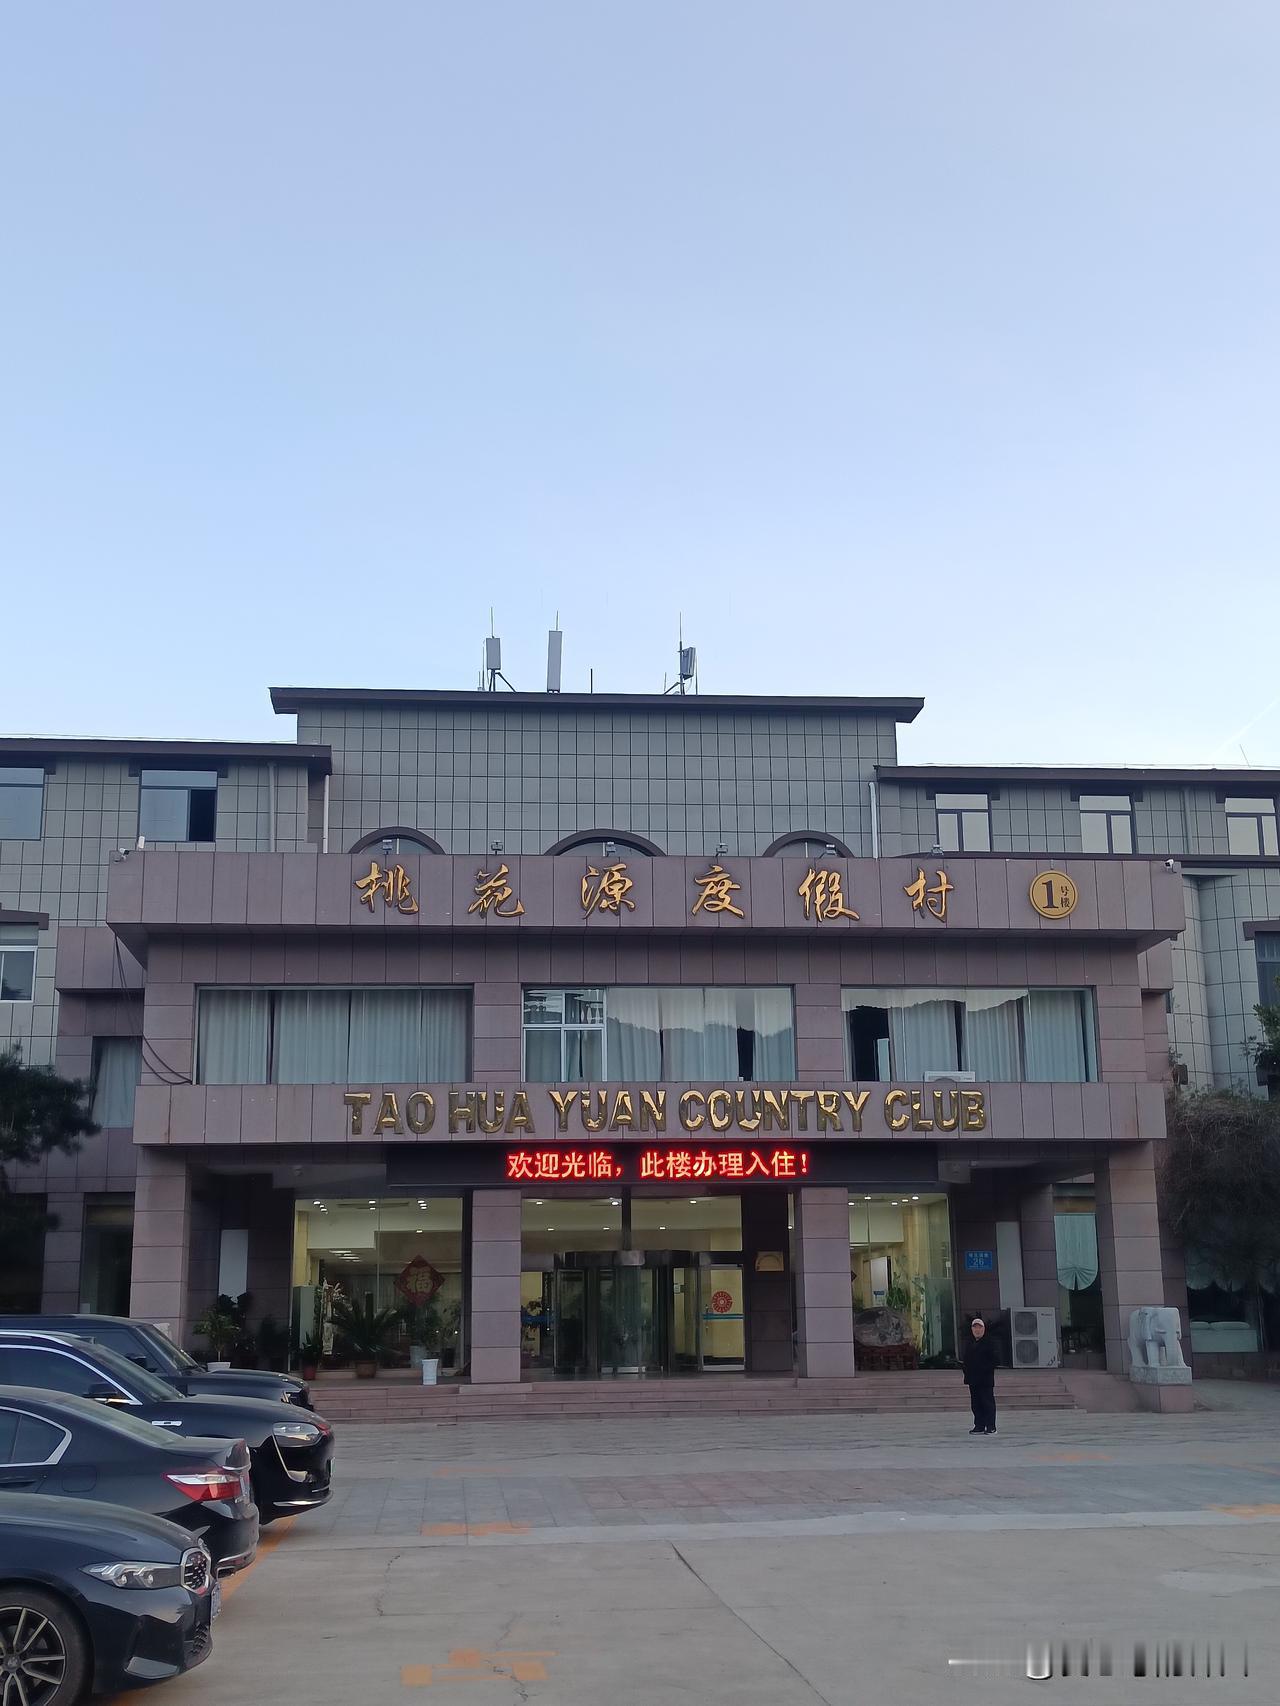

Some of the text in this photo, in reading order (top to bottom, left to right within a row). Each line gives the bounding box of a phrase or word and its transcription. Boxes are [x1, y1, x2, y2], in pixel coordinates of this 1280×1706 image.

[343, 1088, 987, 1135] TAO HUA YUAN COUNTRY CLUB
[406, 1267, 433, 1294] 福
